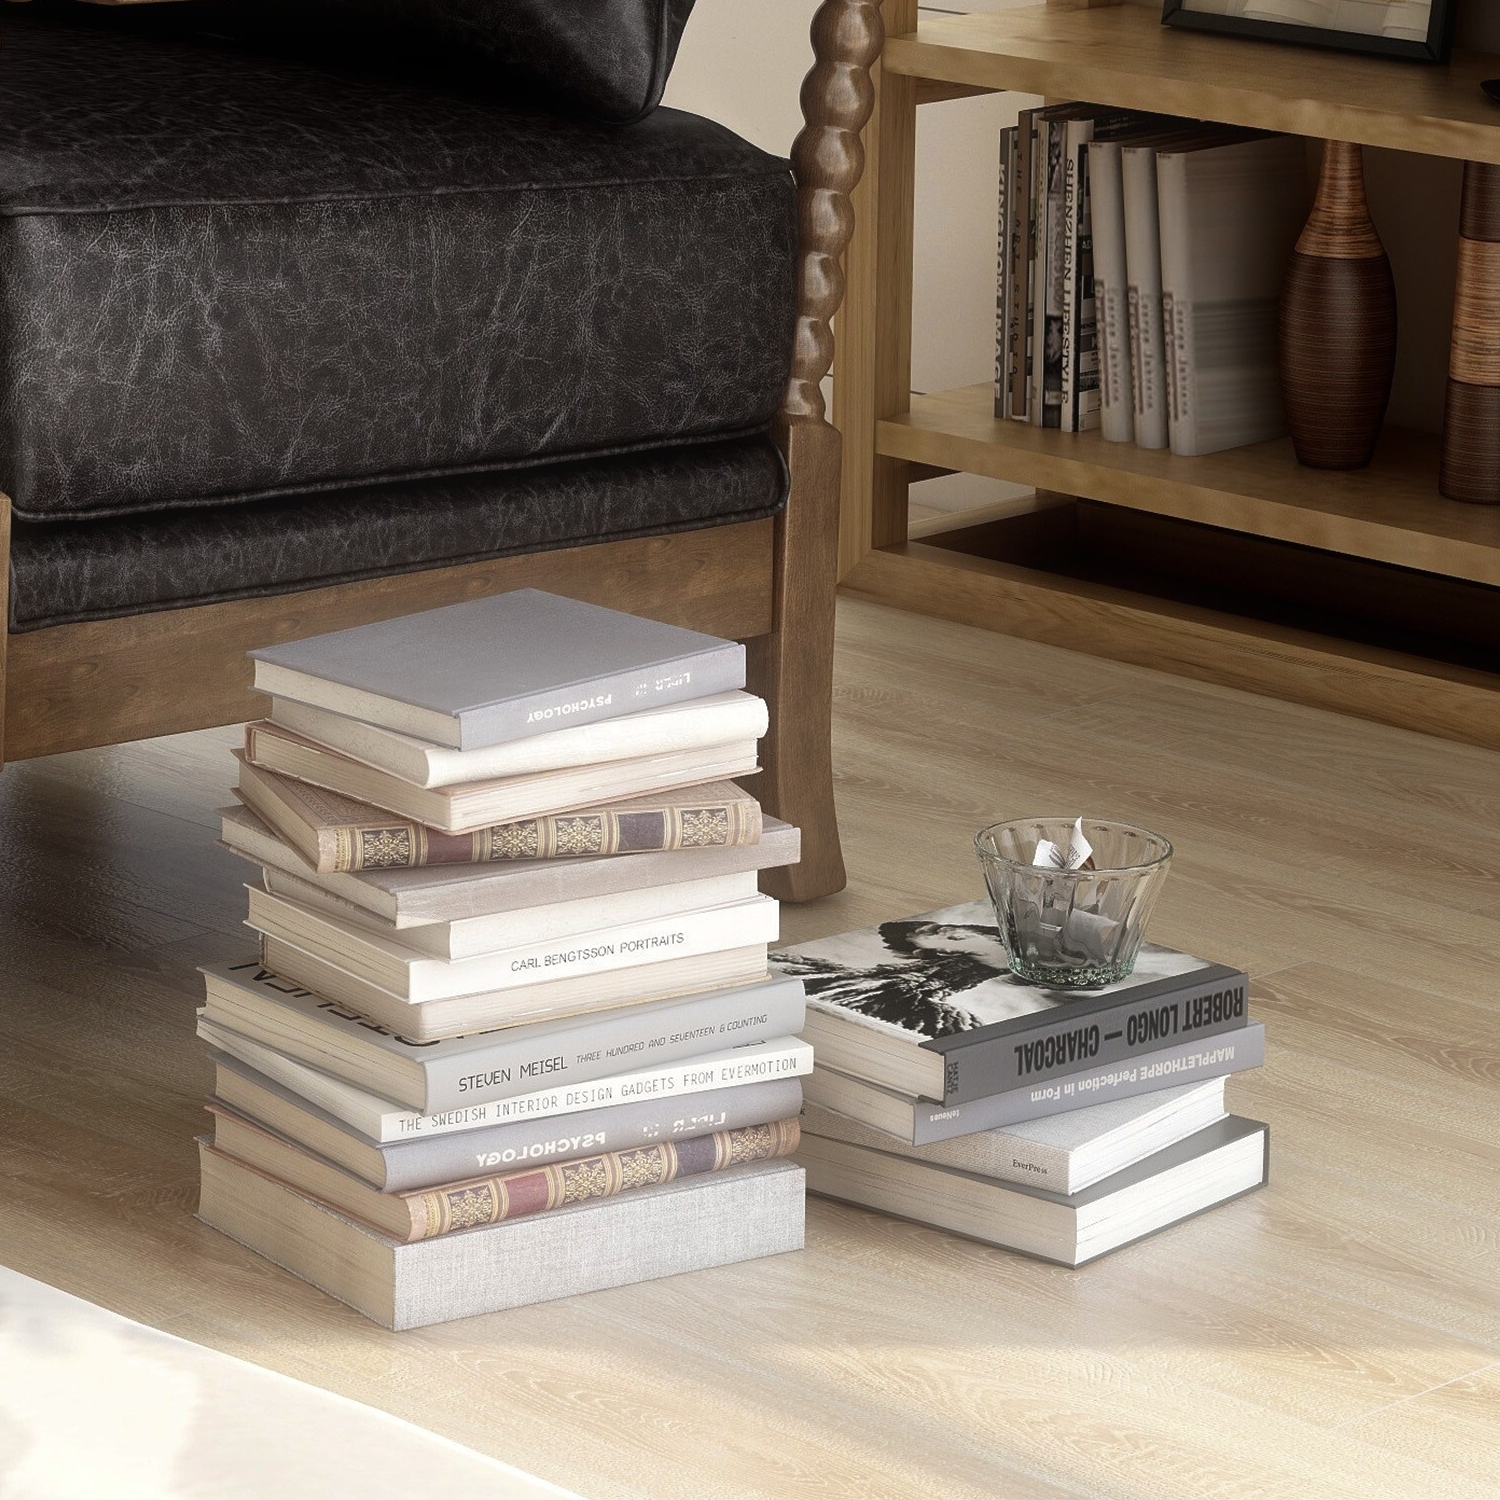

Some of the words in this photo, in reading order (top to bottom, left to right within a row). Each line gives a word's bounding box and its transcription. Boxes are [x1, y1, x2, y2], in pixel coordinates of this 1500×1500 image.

[1063, 158, 1074, 278] SHENZHEN
[1061, 289, 1071, 404] LIFESTYLE
[526, 693, 613, 723] PSYCHOLOGY
[510, 957, 541, 972] CARL
[544, 944, 615, 967] BENGTSSON
[619, 932, 685, 953] PORTRAITS
[1126, 1003, 1180, 1047] LONGO
[1182, 985, 1245, 1032] ROBERT
[458, 1067, 511, 1093] STEVEN
[519, 1056, 568, 1079] MEISEL
[576, 1051, 601, 1064] THREE
[605, 1041, 645, 1058] HUNDRED
[648, 1037, 666, 1048] AND
[669, 1026, 716, 1043] SEVENTEEN
[726, 1014, 768, 1031] COUNTING
[1013, 1024, 1100, 1077] CHARCOAL
[1140, 1045, 1236, 1080] MAPPLETHORPE
[398, 1117, 422, 1133] THE
[431, 1107, 487, 1127] SWEDISH
[496, 1095, 558, 1118] INTERIOR
[566, 1086, 614, 1106] DESIGN
[620, 1077, 675, 1097] GADGETS
[683, 1071, 714, 1087] FROM
[721, 1056, 798, 1081] EVERMOTION
[1030, 1085, 1060, 1102] Form
[1063, 1080, 1076, 1096] in
[1077, 1067, 1138, 1092] Perfection
[1012, 1158, 1048, 1175] EverPress
